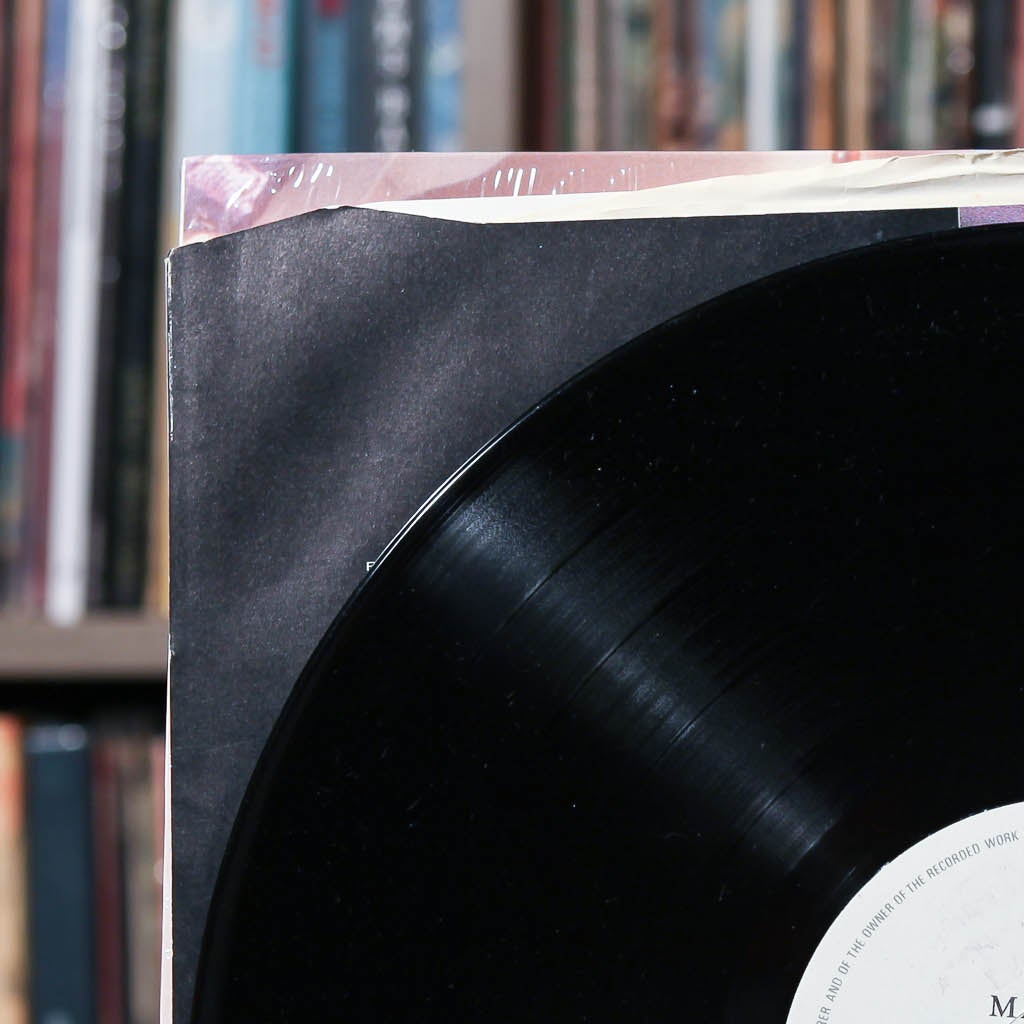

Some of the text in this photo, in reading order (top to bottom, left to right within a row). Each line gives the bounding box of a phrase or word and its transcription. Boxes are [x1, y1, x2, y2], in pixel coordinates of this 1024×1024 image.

[826, 977, 843, 1002] AND
[838, 961, 851, 976] OF
[848, 938, 866, 959] THE
[862, 902, 895, 939] OWNER
[892, 890, 908, 905] OF
[906, 875, 928, 894] THE
[926, 843, 981, 879] RECORDED
[984, 830, 1020, 849] WORK
